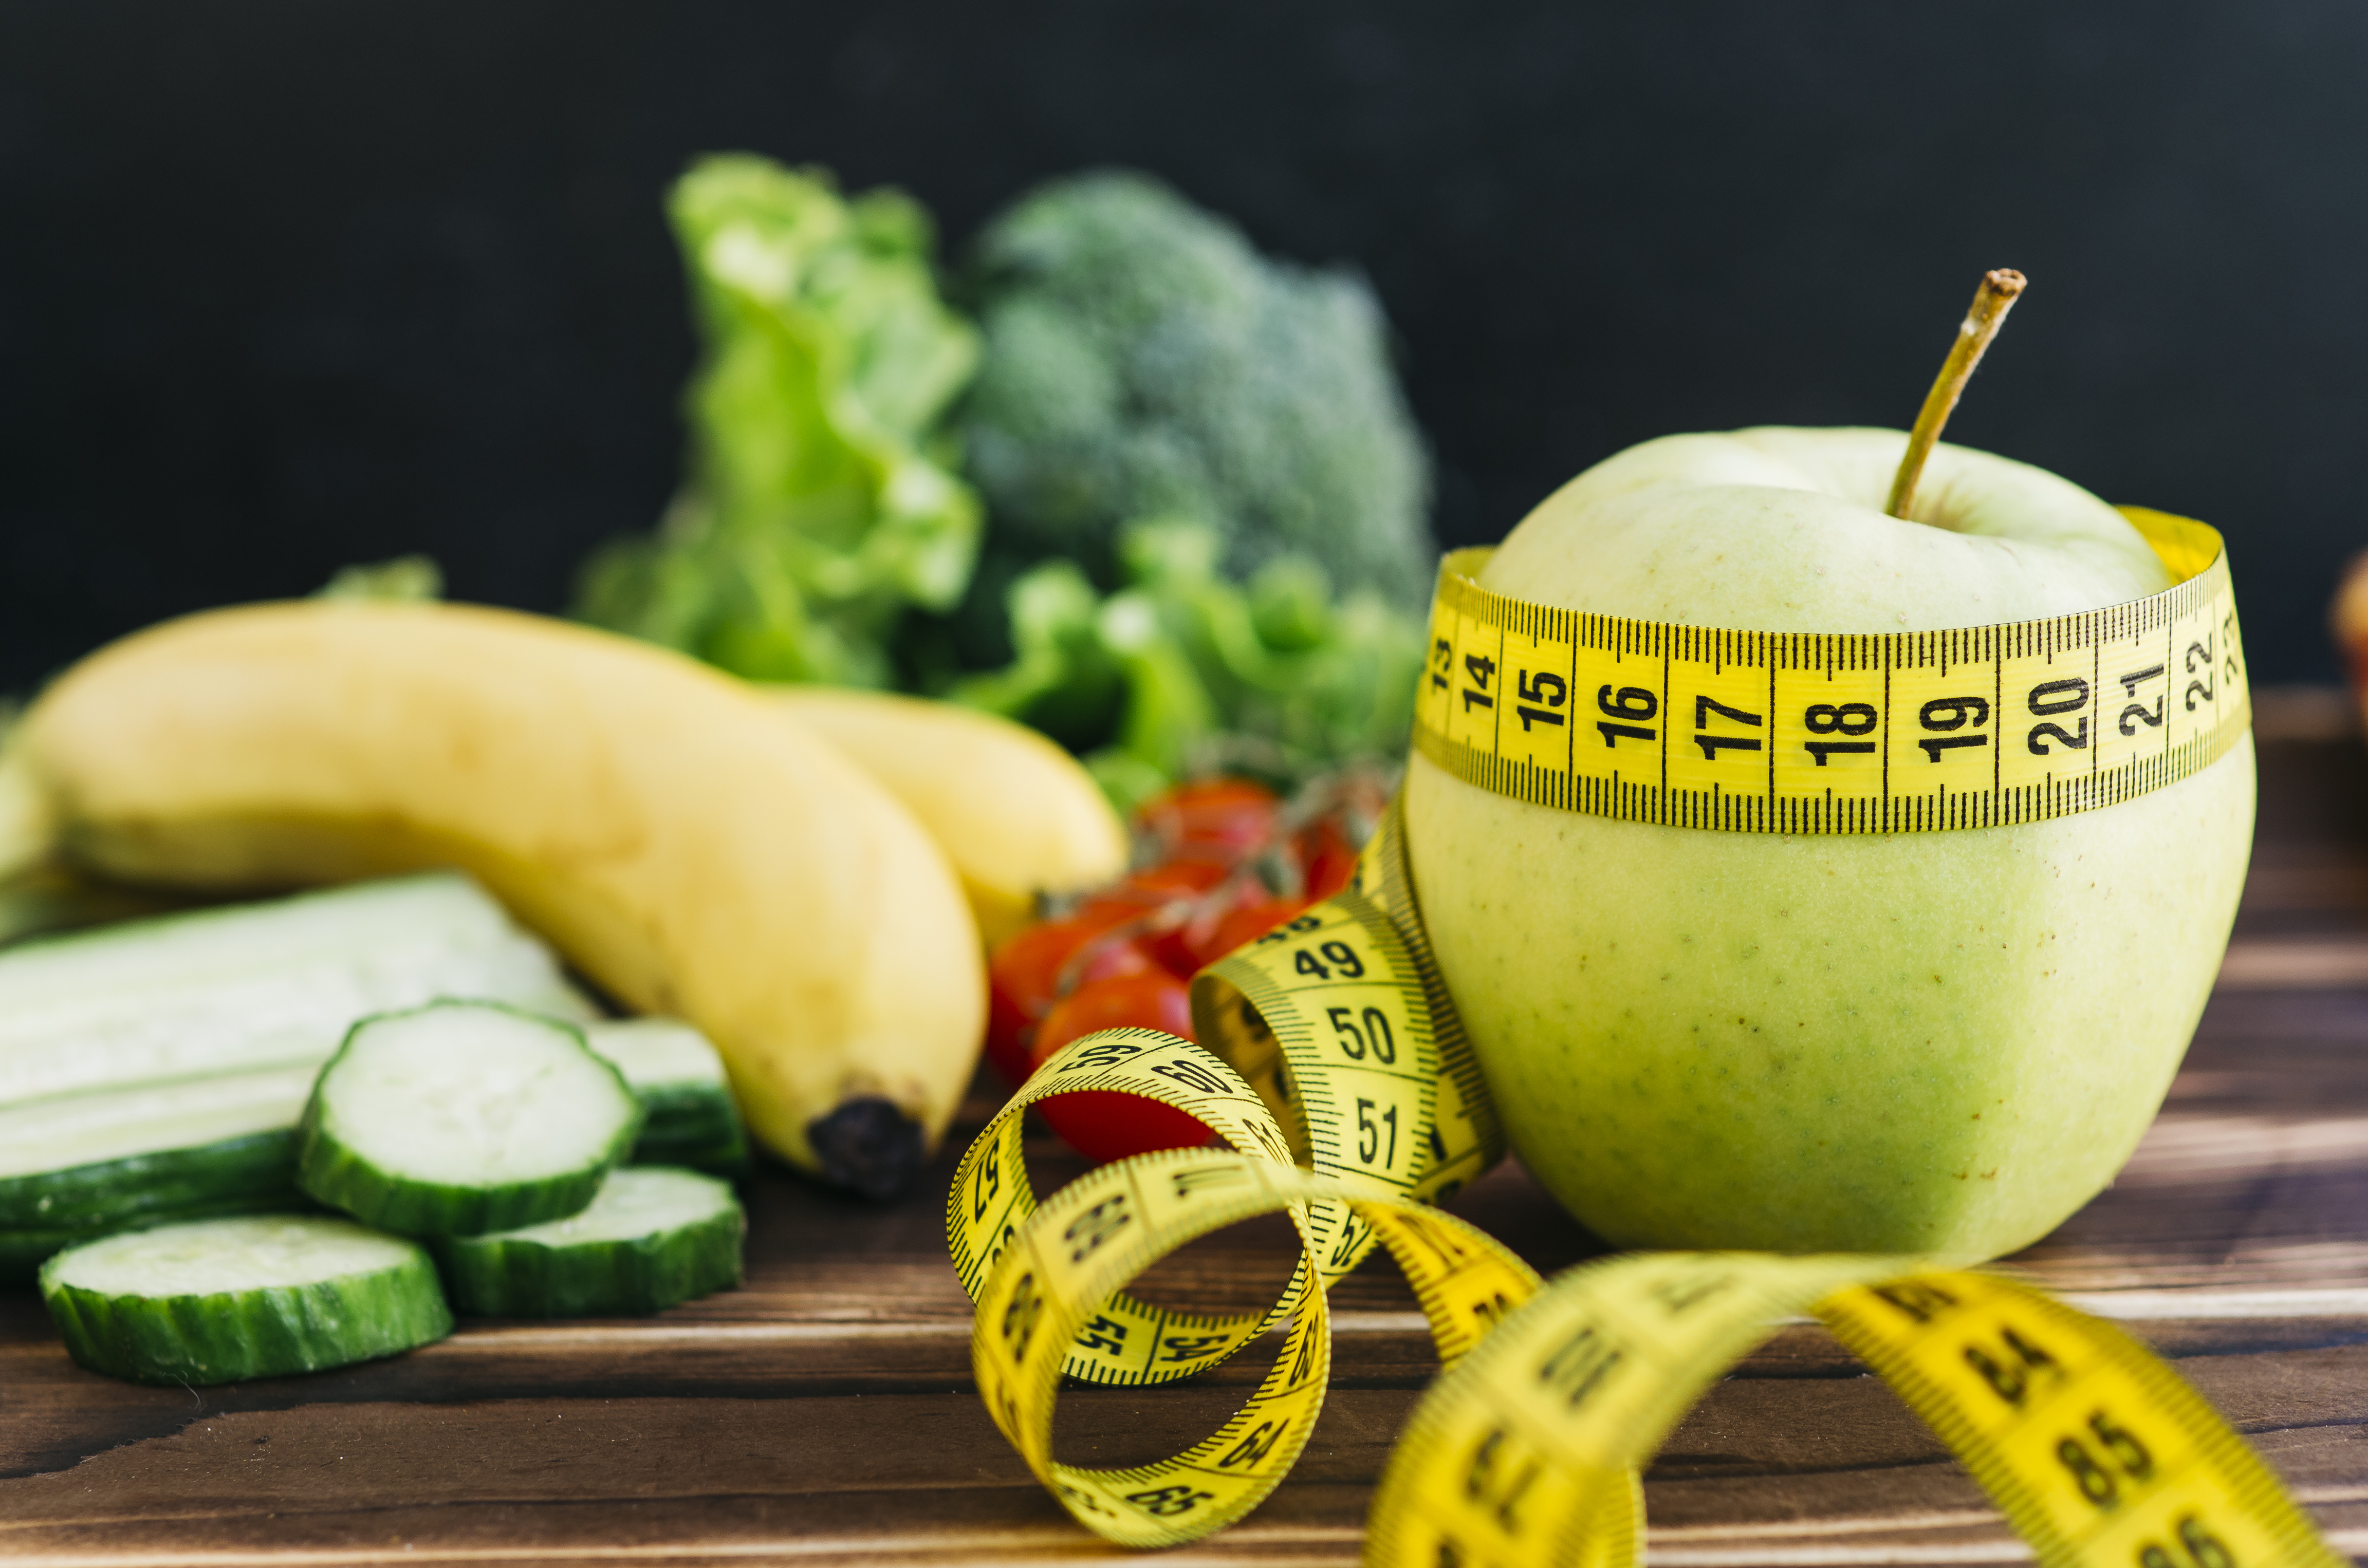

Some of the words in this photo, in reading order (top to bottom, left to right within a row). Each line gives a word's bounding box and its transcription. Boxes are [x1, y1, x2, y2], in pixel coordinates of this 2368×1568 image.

[1463, 653, 1495, 713] 14
[1516, 668, 1567, 732] 15
[2119, 664, 2164, 737] 21
[2186, 631, 2213, 711] 22
[1596, 684, 1658, 748] 16
[1694, 695, 1762, 760] 17
[1804, 702, 1878, 767] 18
[1918, 696, 1990, 763] 19
[2026, 677, 2089, 757] 20
[1294, 940, 1365, 980] 49
[1055, 1044, 1143, 1074] 59
[1326, 1006, 1396, 1065] 50
[1150, 1059, 1234, 1094] 60
[1357, 1097, 1397, 1170] 51
[974, 1137, 1000, 1225] 57
[1073, 1314, 1127, 1357] 55
[1160, 1334, 1230, 1362] 54
[1218, 1417, 1291, 1470] 64
[2053, 1409, 2158, 1509] 85
